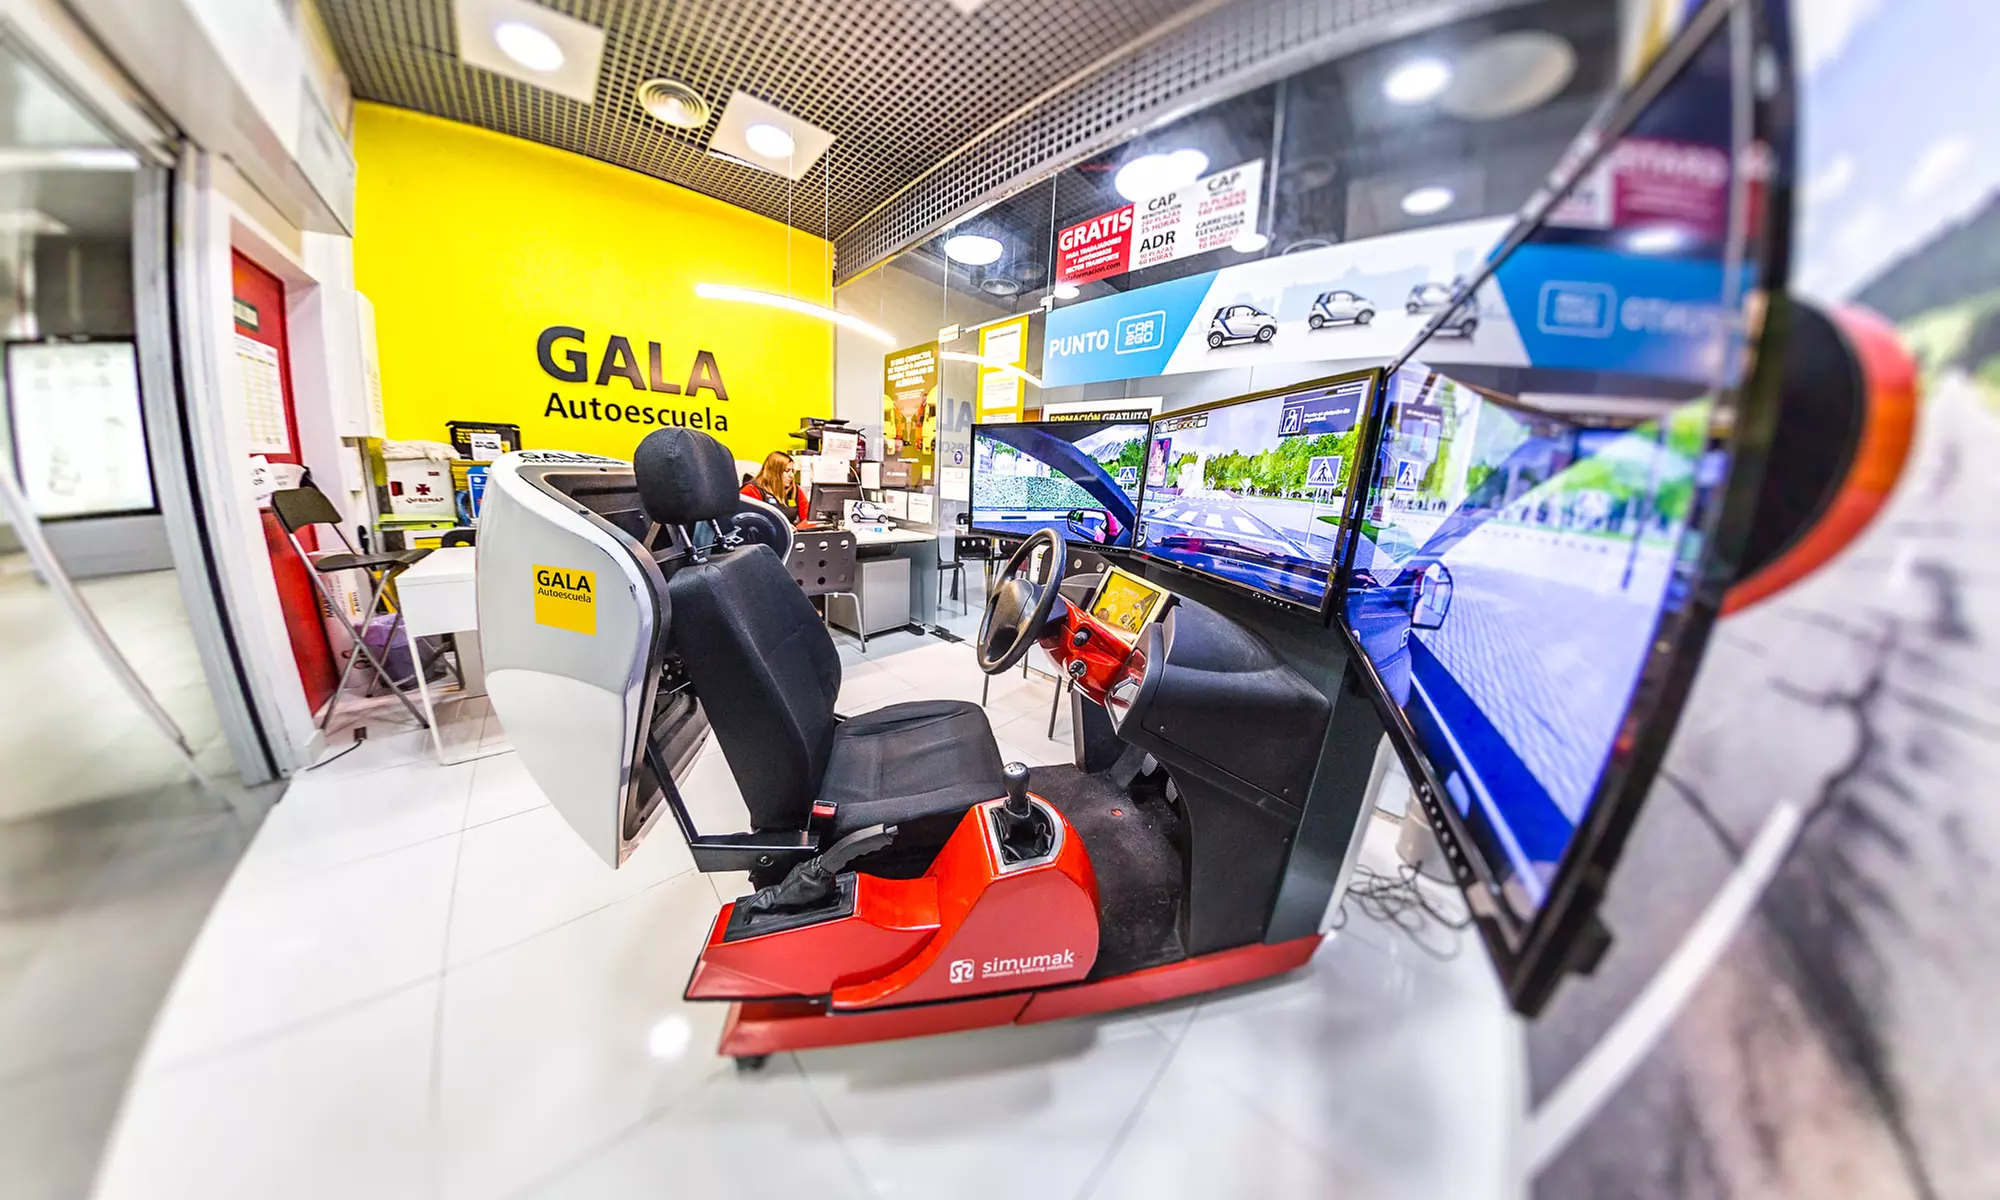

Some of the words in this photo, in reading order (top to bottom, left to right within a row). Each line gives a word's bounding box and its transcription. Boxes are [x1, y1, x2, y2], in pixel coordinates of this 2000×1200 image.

[1207, 171, 1241, 191] CAP
[1148, 192, 1176, 211] CAP
[1060, 208, 1132, 251] GRATIS
[1152, 217, 1180, 231] HORAS
[1140, 230, 1176, 253] ADR
[1149, 251, 1173, 263] HORAS
[1126, 319, 1155, 335] CAR
[1049, 328, 1110, 360] PUNTO
[1125, 331, 1154, 347] 2GO
[537, 326, 729, 401] GALA
[544, 393, 728, 432] Autoescuela
[1050, 412, 1101, 422] FORMACIÓN
[1102, 411, 1149, 421] GRATUITA
[537, 570, 592, 593] GALA
[538, 586, 592, 603] Autoescuela
[982, 949, 1075, 974] simumak
